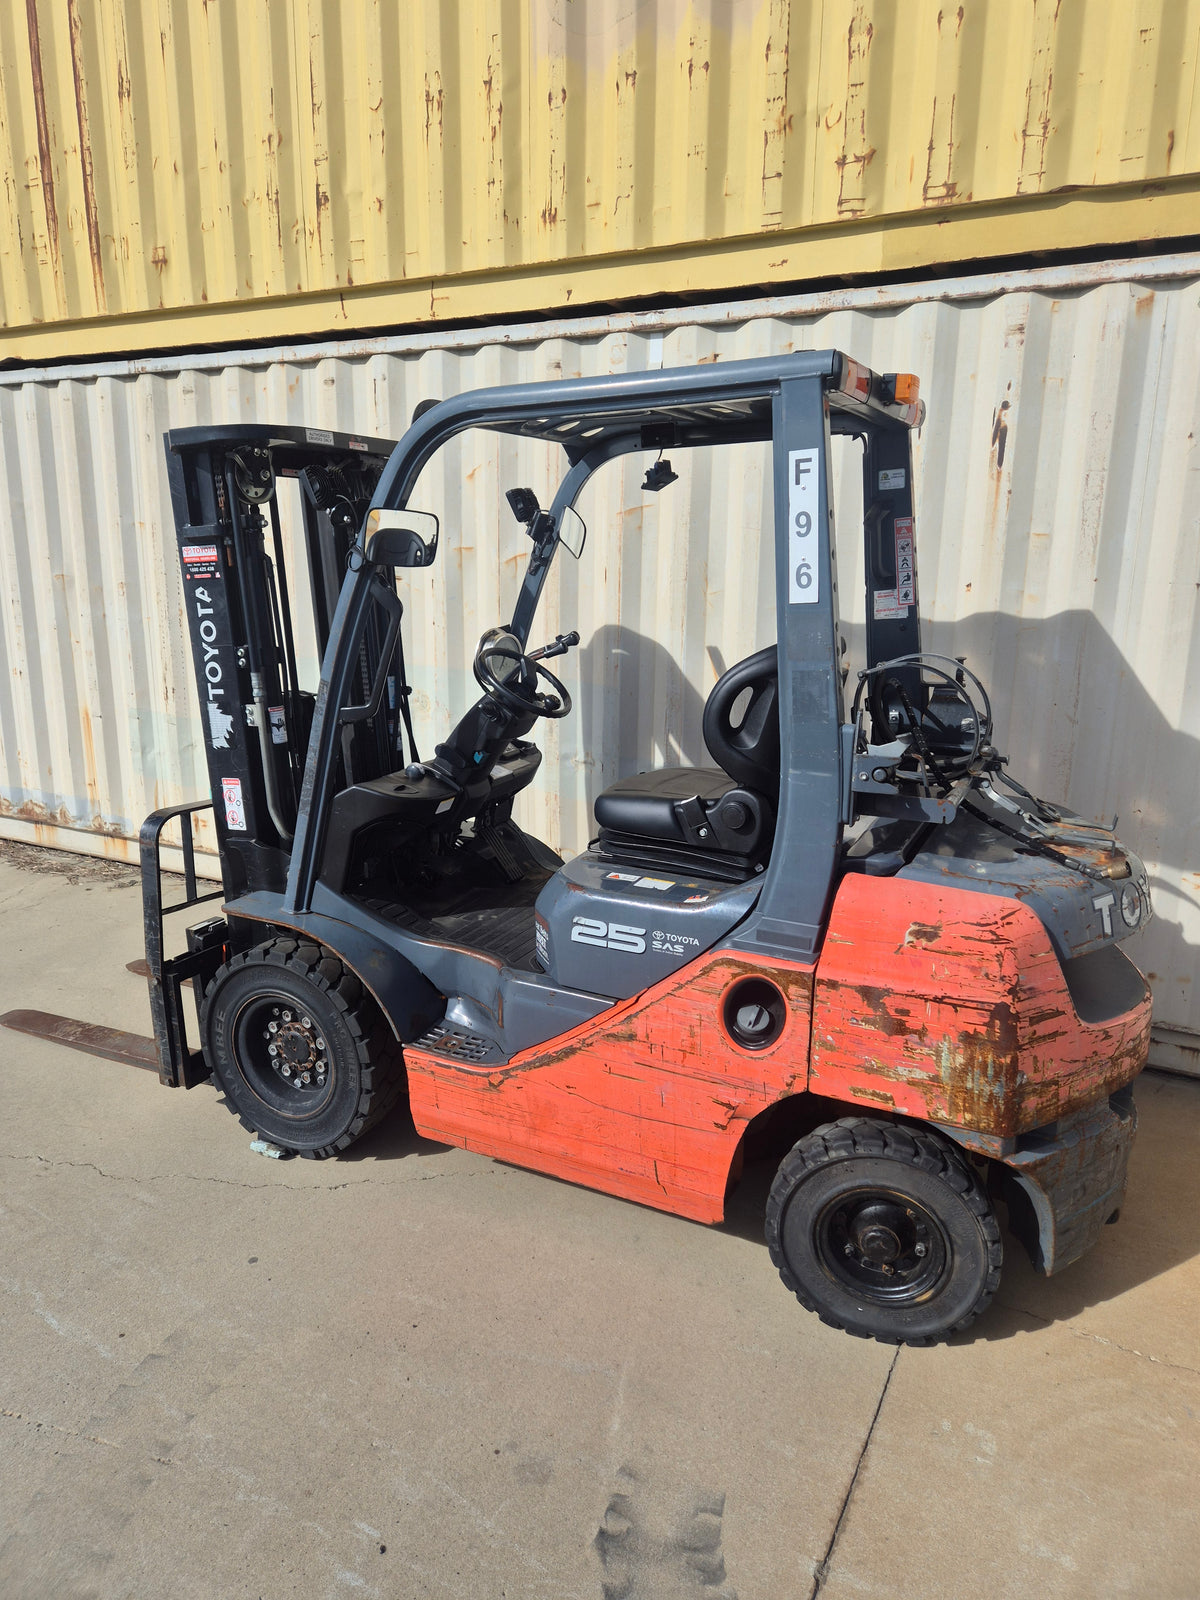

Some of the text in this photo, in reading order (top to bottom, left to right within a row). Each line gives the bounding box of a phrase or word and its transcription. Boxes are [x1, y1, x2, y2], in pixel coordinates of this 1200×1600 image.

[195, 586, 225, 701] TOYOTA
[571, 916, 647, 954] 25
[652, 941, 685, 953] SAS
[665, 933, 700, 946] TOYOTA
